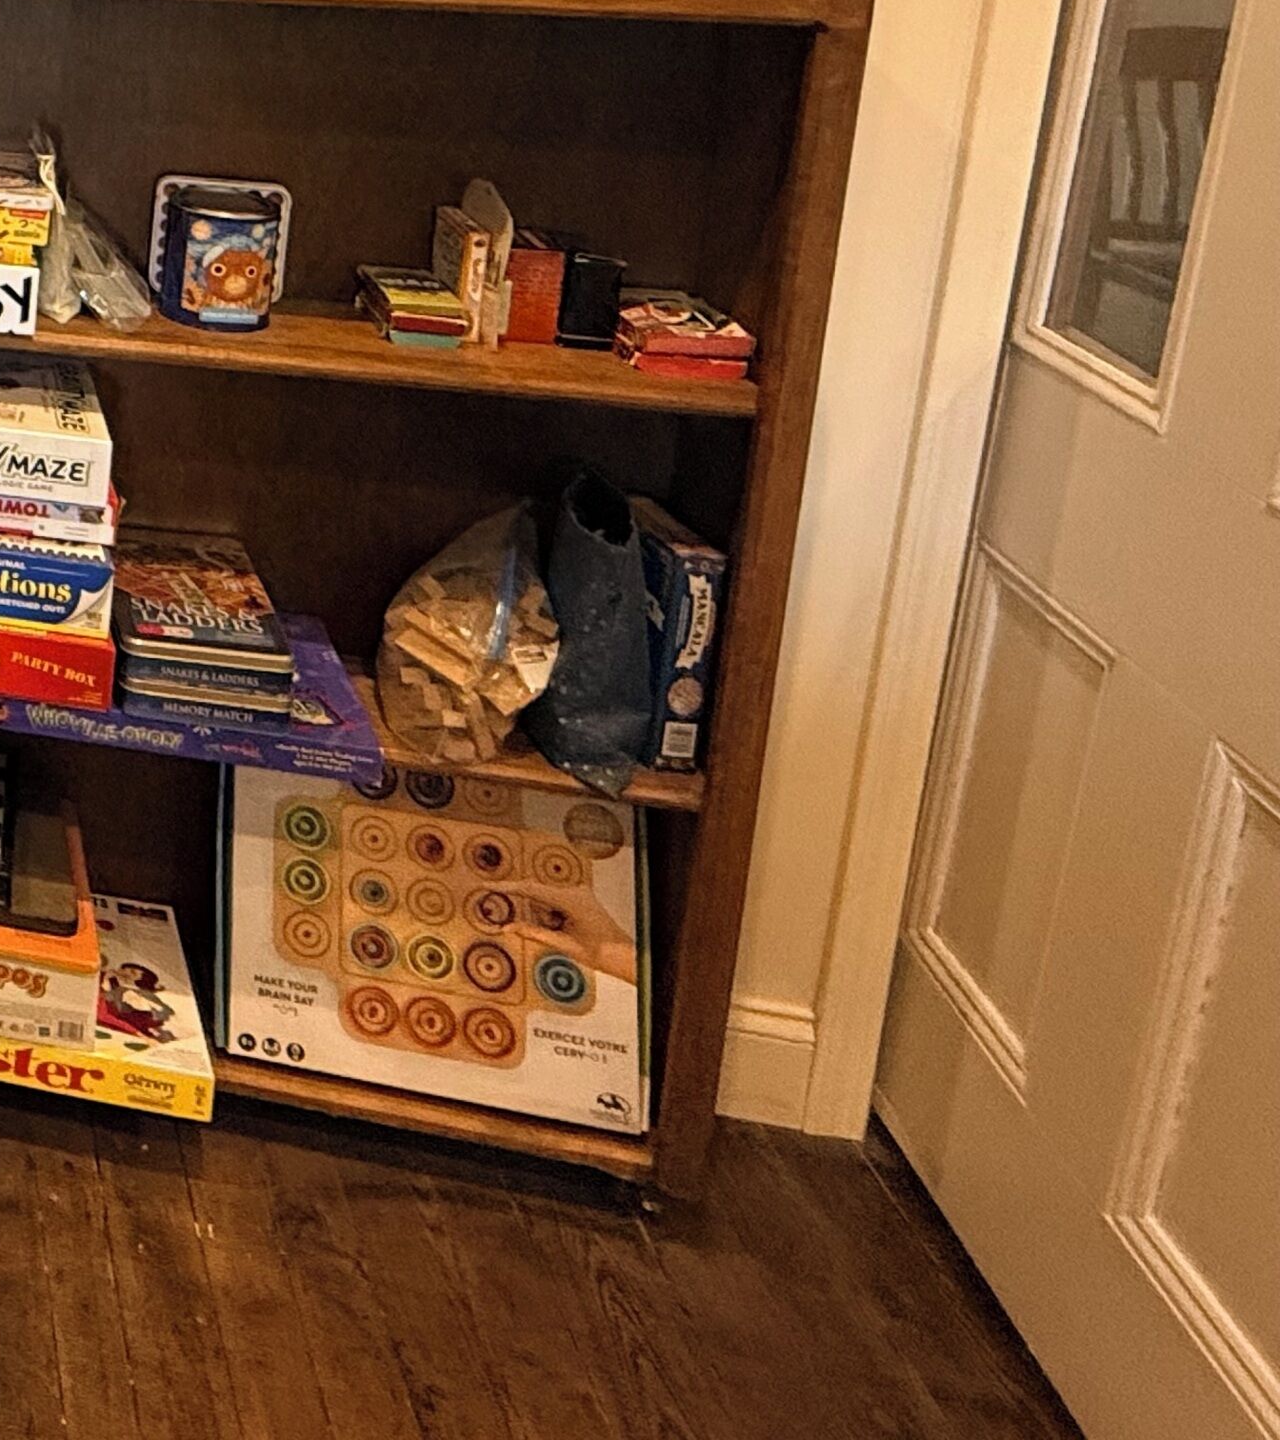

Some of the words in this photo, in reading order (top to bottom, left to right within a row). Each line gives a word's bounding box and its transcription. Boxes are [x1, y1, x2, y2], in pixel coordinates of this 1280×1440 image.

[6, 455, 86, 483] MAZE
[27, 482, 54, 493] GAME
[131, 597, 230, 620] SNAKES
[140, 608, 264, 634] LADDERS
[687, 587, 709, 658] MANCALA
[11, 651, 62, 676] PARTY
[64, 668, 96, 688] BOX
[160, 666, 200, 679] SNAKES
[211, 673, 260, 687] LADDERS
[163, 701, 212, 718] MEMORY
[214, 709, 254, 723] MATCH
[253, 973, 285, 988] MAKE
[287, 980, 318, 994] YOUR
[258, 987, 292, 1002] BRAIN
[293, 994, 315, 1007] SAY
[532, 1027, 585, 1047] EXERCEZ
[589, 1037, 628, 1054] VOTRE
